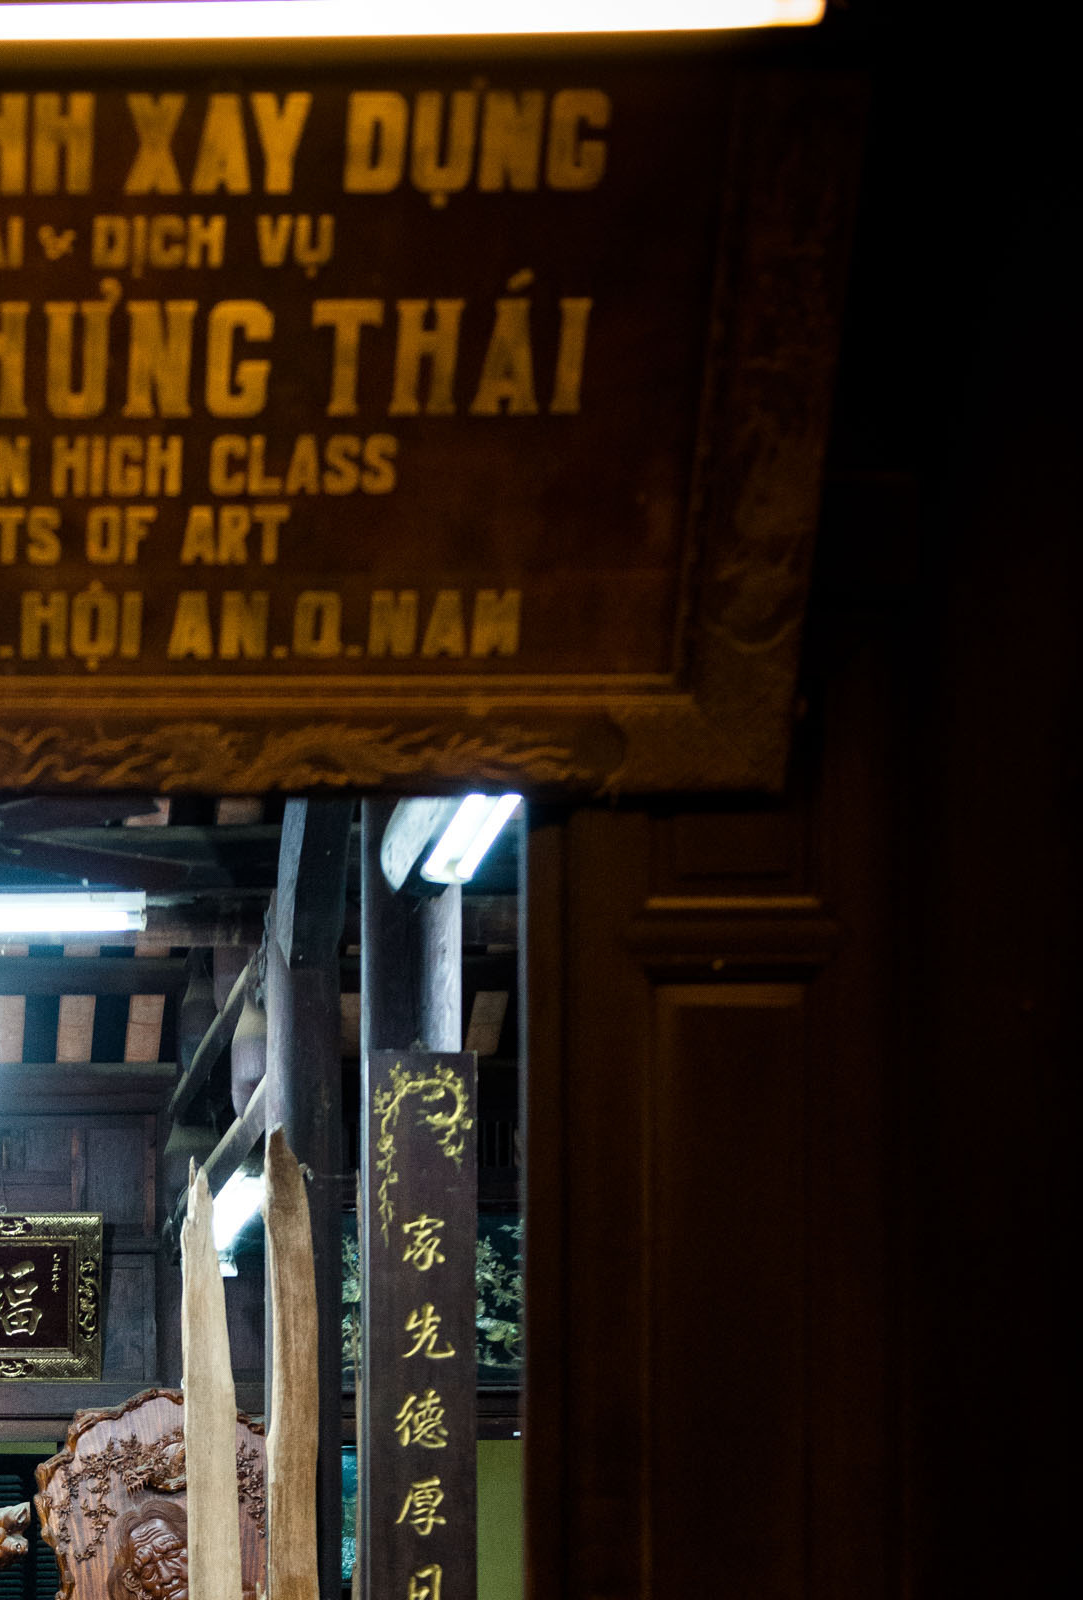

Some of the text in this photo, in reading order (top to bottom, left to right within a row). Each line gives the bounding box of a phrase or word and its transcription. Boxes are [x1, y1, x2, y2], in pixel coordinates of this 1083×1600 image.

[91, 216, 226, 280] DỊCH
[257, 215, 336, 279] VỤ
[313, 269, 593, 417] THÁI
[51, 436, 183, 497] HIGH
[210, 434, 399, 496] CLASS
[85, 506, 159, 565] OF
[181, 505, 292, 565] ART
